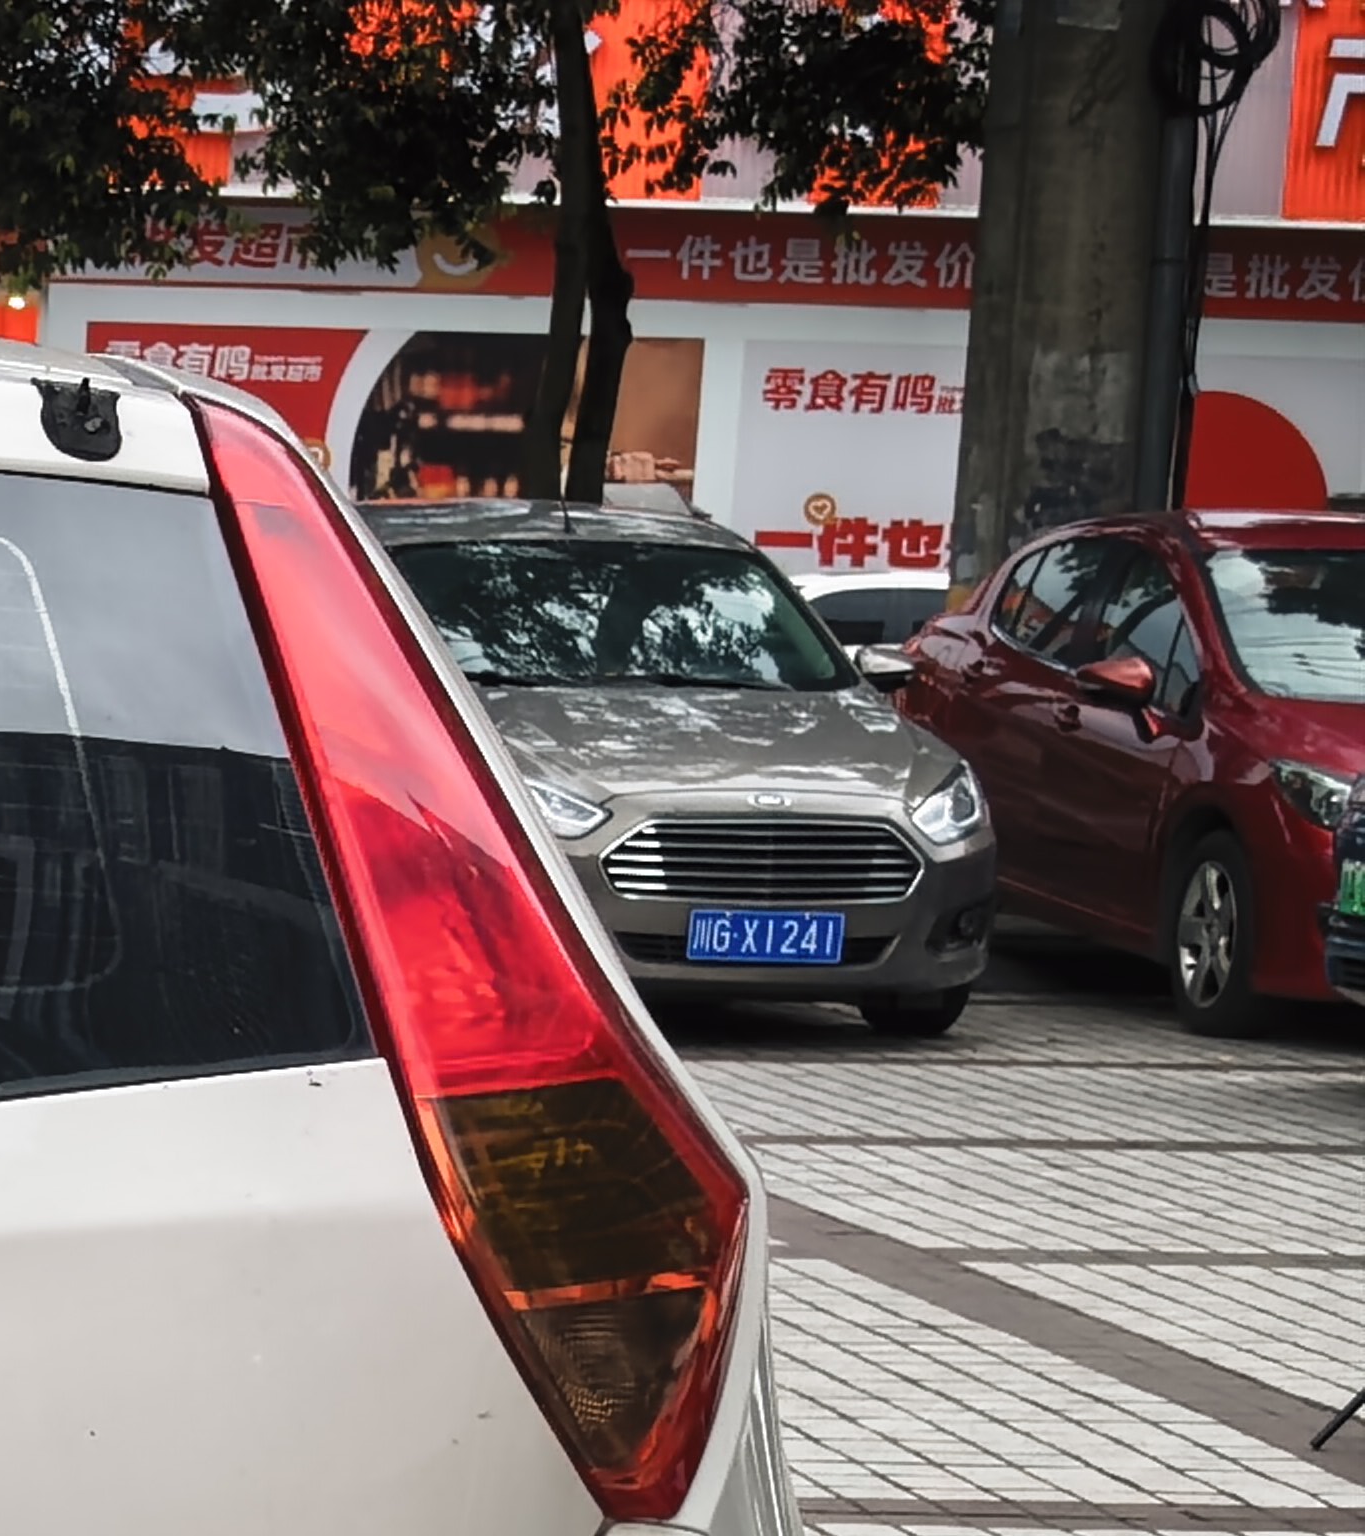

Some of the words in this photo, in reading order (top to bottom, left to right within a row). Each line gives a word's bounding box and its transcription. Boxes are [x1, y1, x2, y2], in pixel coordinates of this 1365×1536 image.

[625, 234, 975, 289] 一件也是批发价
[754, 517, 952, 569] 一件也
